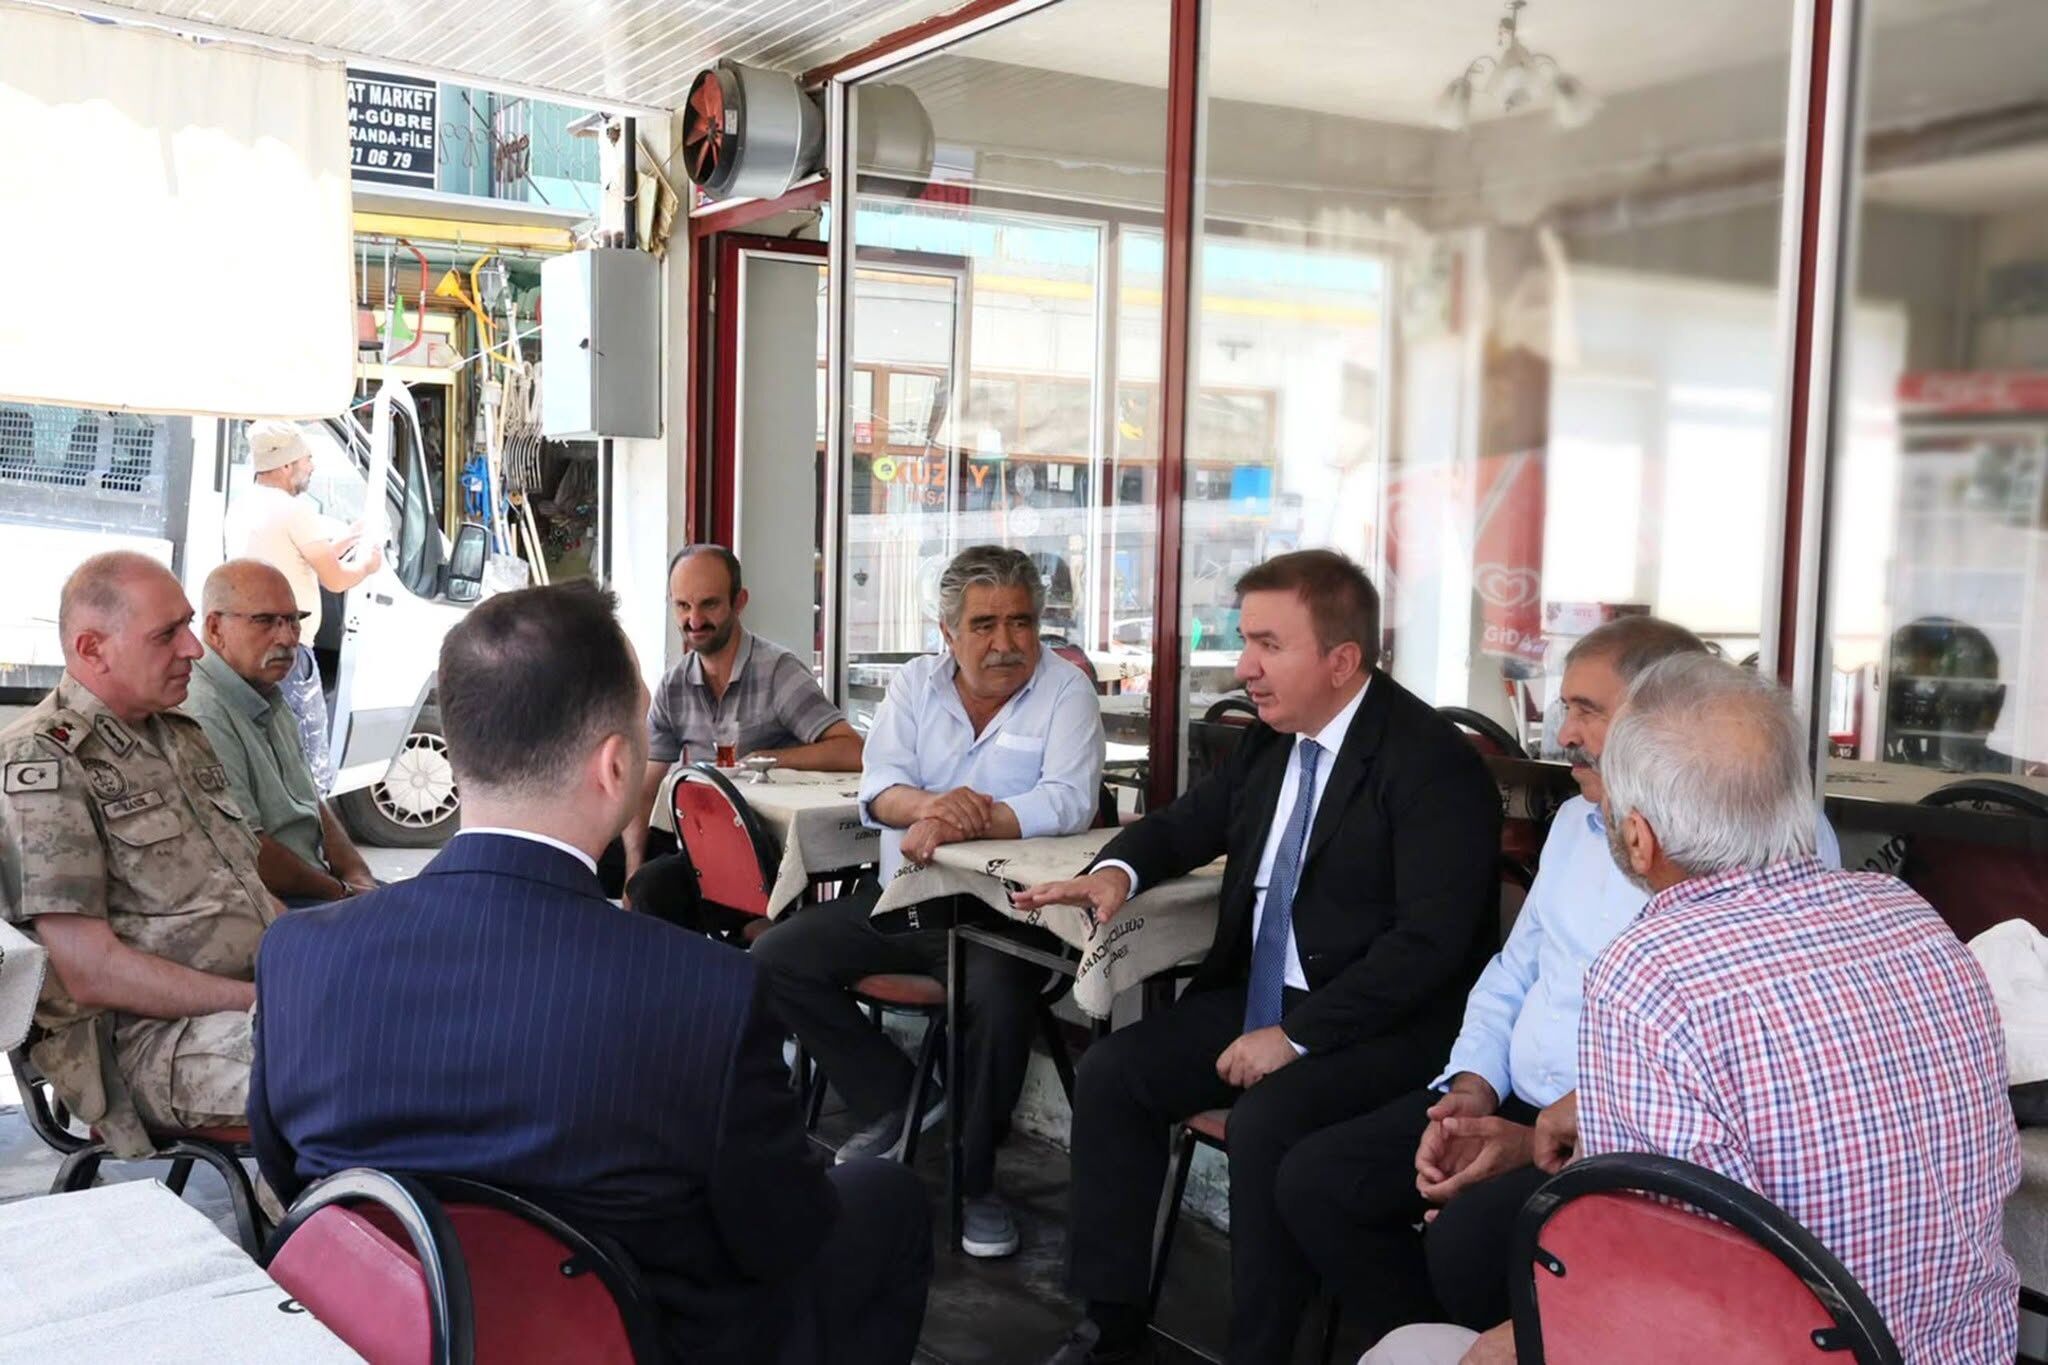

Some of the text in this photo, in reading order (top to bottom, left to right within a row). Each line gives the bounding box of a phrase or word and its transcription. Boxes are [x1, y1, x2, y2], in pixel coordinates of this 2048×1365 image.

[369, 84, 433, 112] MARKET
[367, 148, 389, 166] 06
[392, 150, 412, 169] 79
